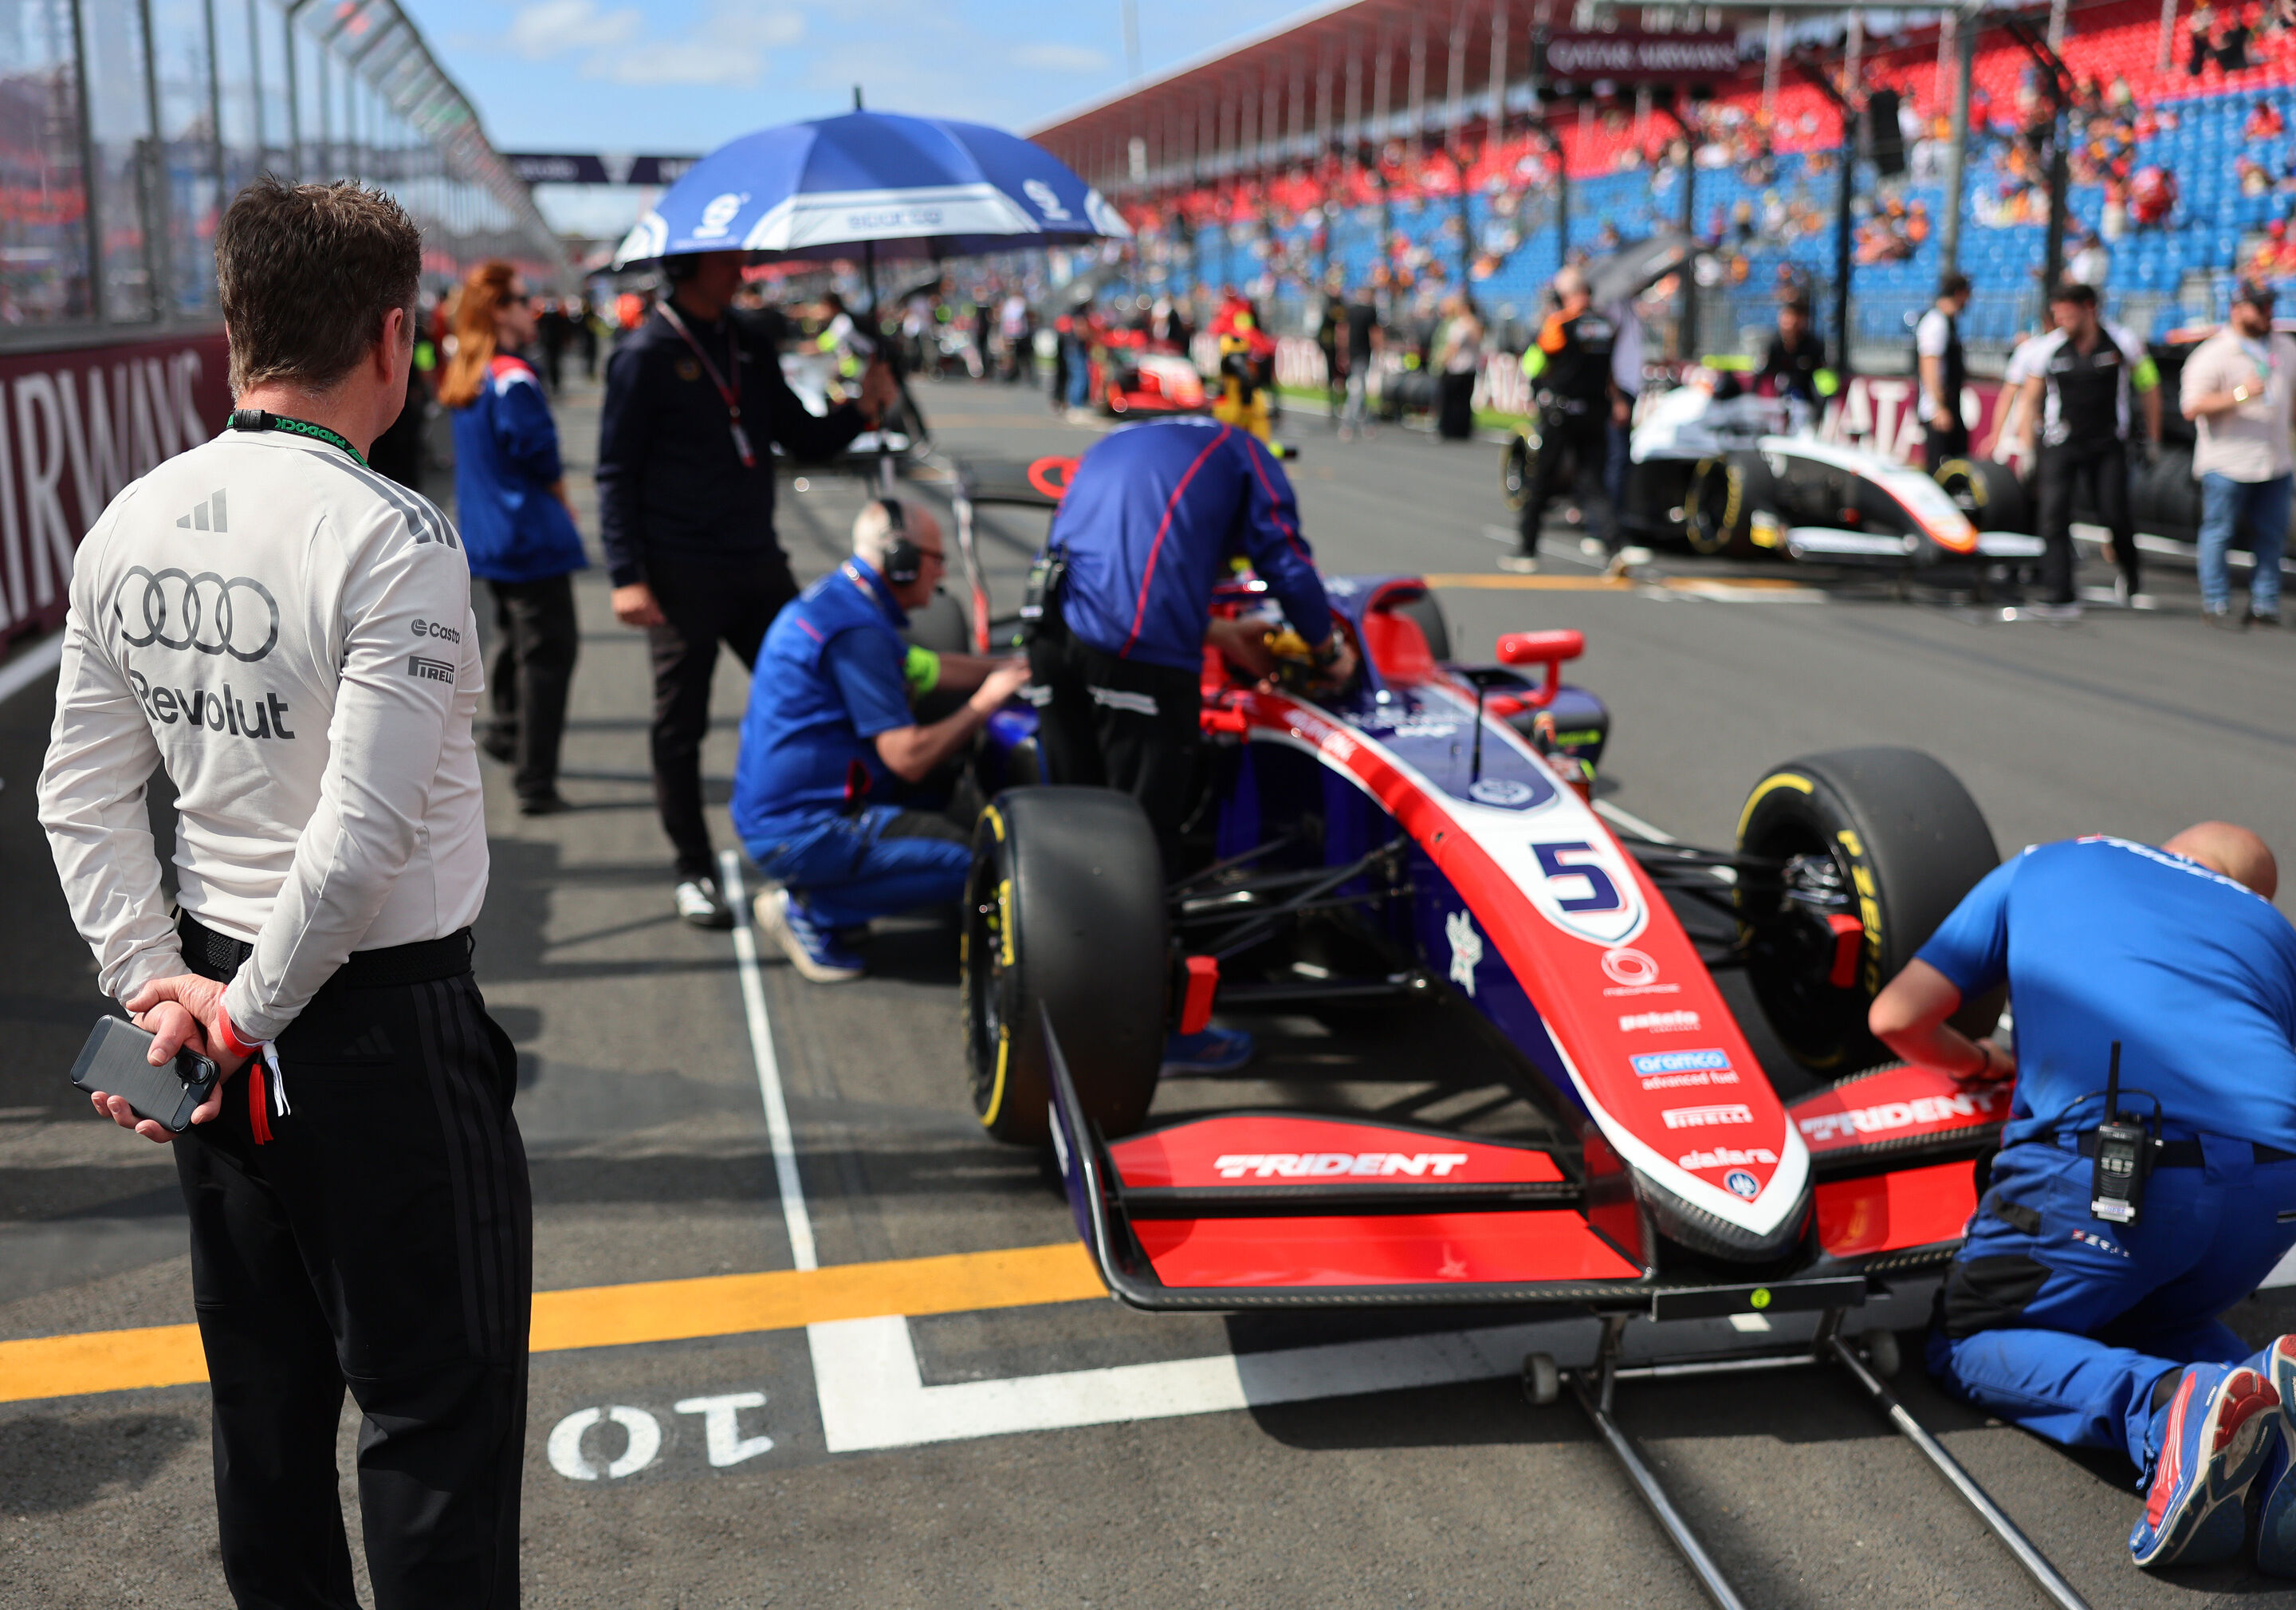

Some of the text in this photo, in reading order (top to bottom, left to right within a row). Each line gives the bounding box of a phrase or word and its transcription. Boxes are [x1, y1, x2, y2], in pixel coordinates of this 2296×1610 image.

[274, 418, 346, 449] PADDOCK
[0, 348, 209, 632] IRWAYS
[429, 622, 461, 645] Castro
[407, 655, 454, 685] PIRELLI
[129, 668, 296, 740] Revolut
[1531, 841, 1620, 912] 5
[1637, 1051, 1724, 1072] aramco
[1641, 1070, 1740, 1090] advanced fuel
[1661, 1103, 1753, 1129] PIRELLI
[1213, 1152, 1468, 1178] TRIDENT
[1678, 1147, 1779, 1171] dallara
[547, 1392, 774, 1481] 10
